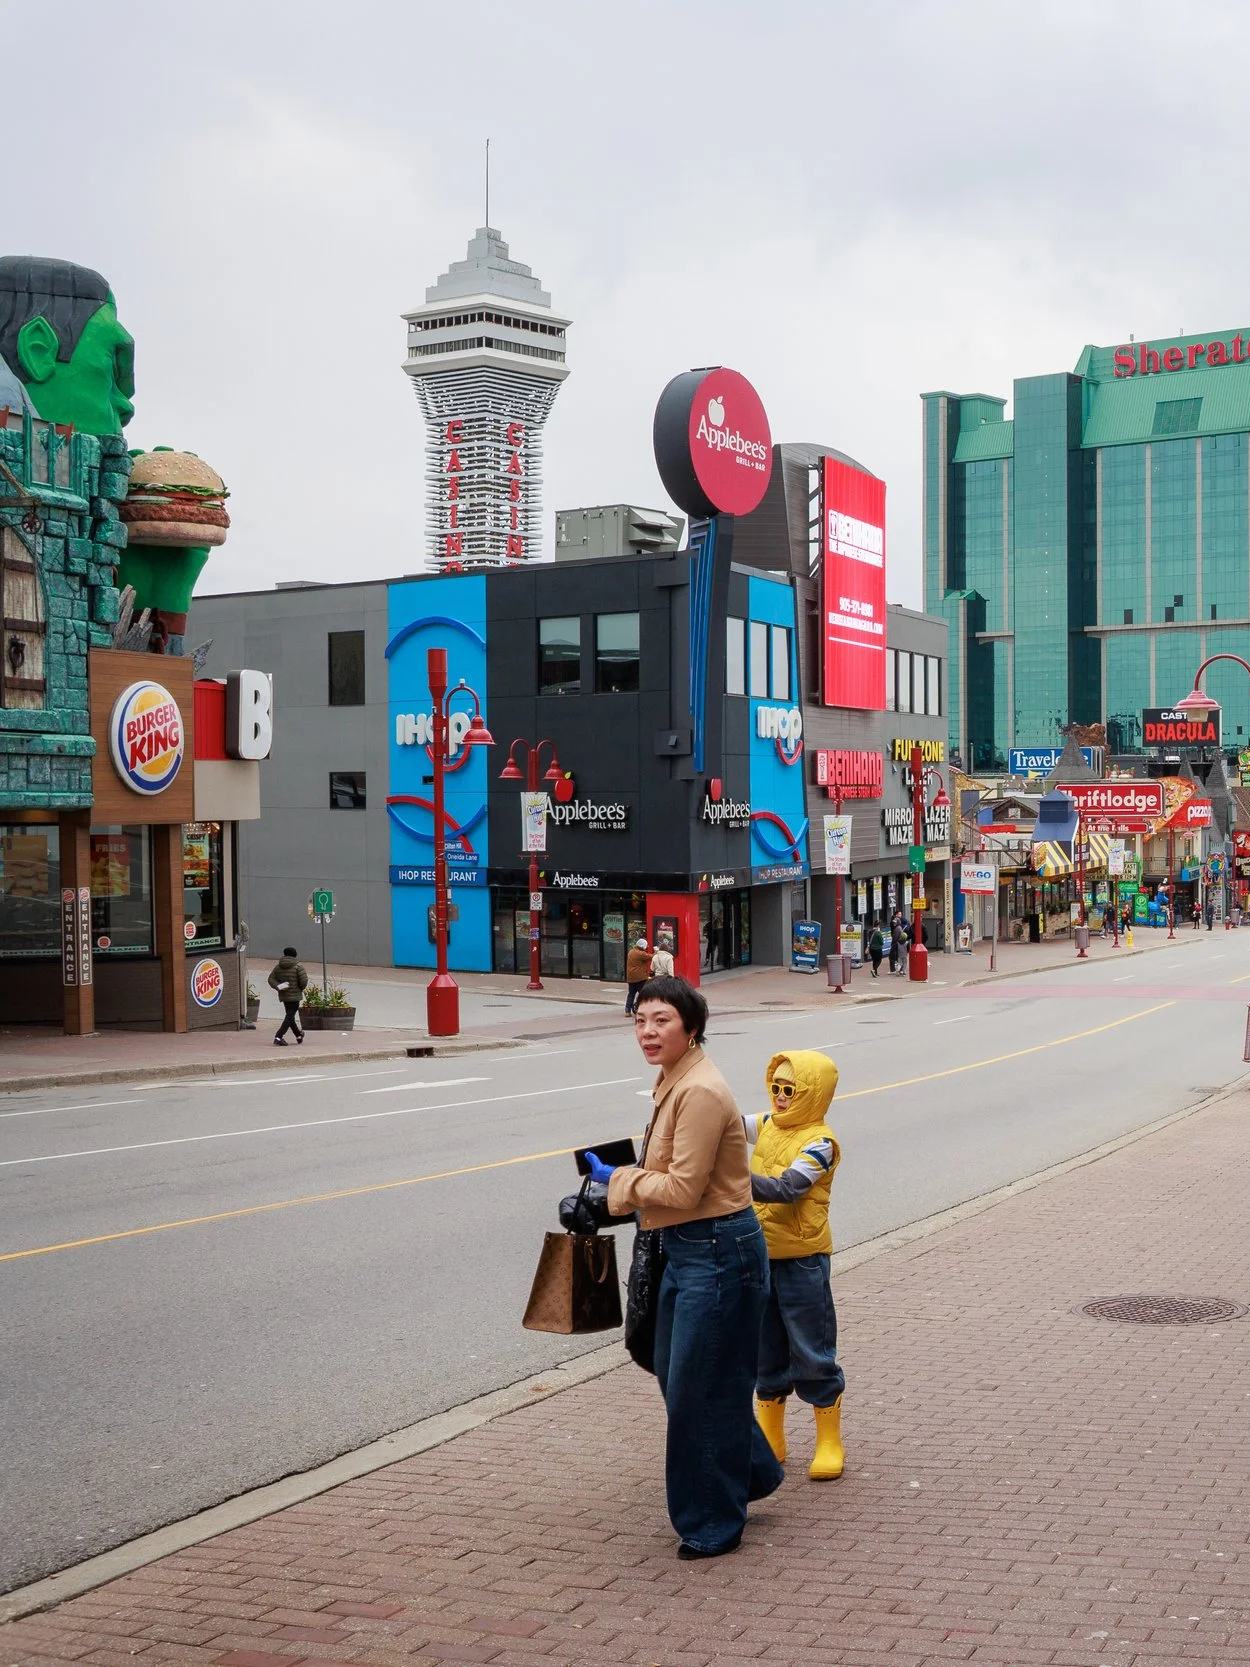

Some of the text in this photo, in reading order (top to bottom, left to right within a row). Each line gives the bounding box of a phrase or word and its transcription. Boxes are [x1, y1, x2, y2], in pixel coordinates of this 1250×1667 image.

[696, 415, 766, 460] Applebee's
[736, 456, 750, 467] GRILL
[755, 462, 766, 471] BAR
[506, 423, 525, 567] CASIN
[127, 703, 176, 743] BURGER
[239, 669, 272, 760] B
[1161, 712, 1188, 720] CAST
[1145, 722, 1216, 742] DRACULA
[129, 721, 179, 771] KING
[919, 740, 945, 762] ZONE
[828, 750, 882, 785] BENIHANA
[545, 795, 626, 825] Applebee's
[703, 795, 750, 824] Applebee's
[924, 806, 951, 824] LAZER
[889, 826, 913, 846] MAZE
[927, 823, 949, 842] MAZE
[1087, 824, 1095, 832] At
[1098, 824, 1110, 832] the
[96, 844, 126, 852] FRIES
[399, 870, 477, 882] IHOP RESURANT
[552, 872, 599, 888] Applebee's
[711, 874, 735, 889] Applebee's
[771, 865, 803, 878] RESTAURANT
[964, 870, 991, 879] WEGO
[65, 904, 74, 981] ENTRANCE
[81, 903, 90, 980] ENTRANCE
[185, 938, 220, 947] NTRANCE
[196, 967, 219, 986] BURGER
[197, 975, 220, 997] KING
